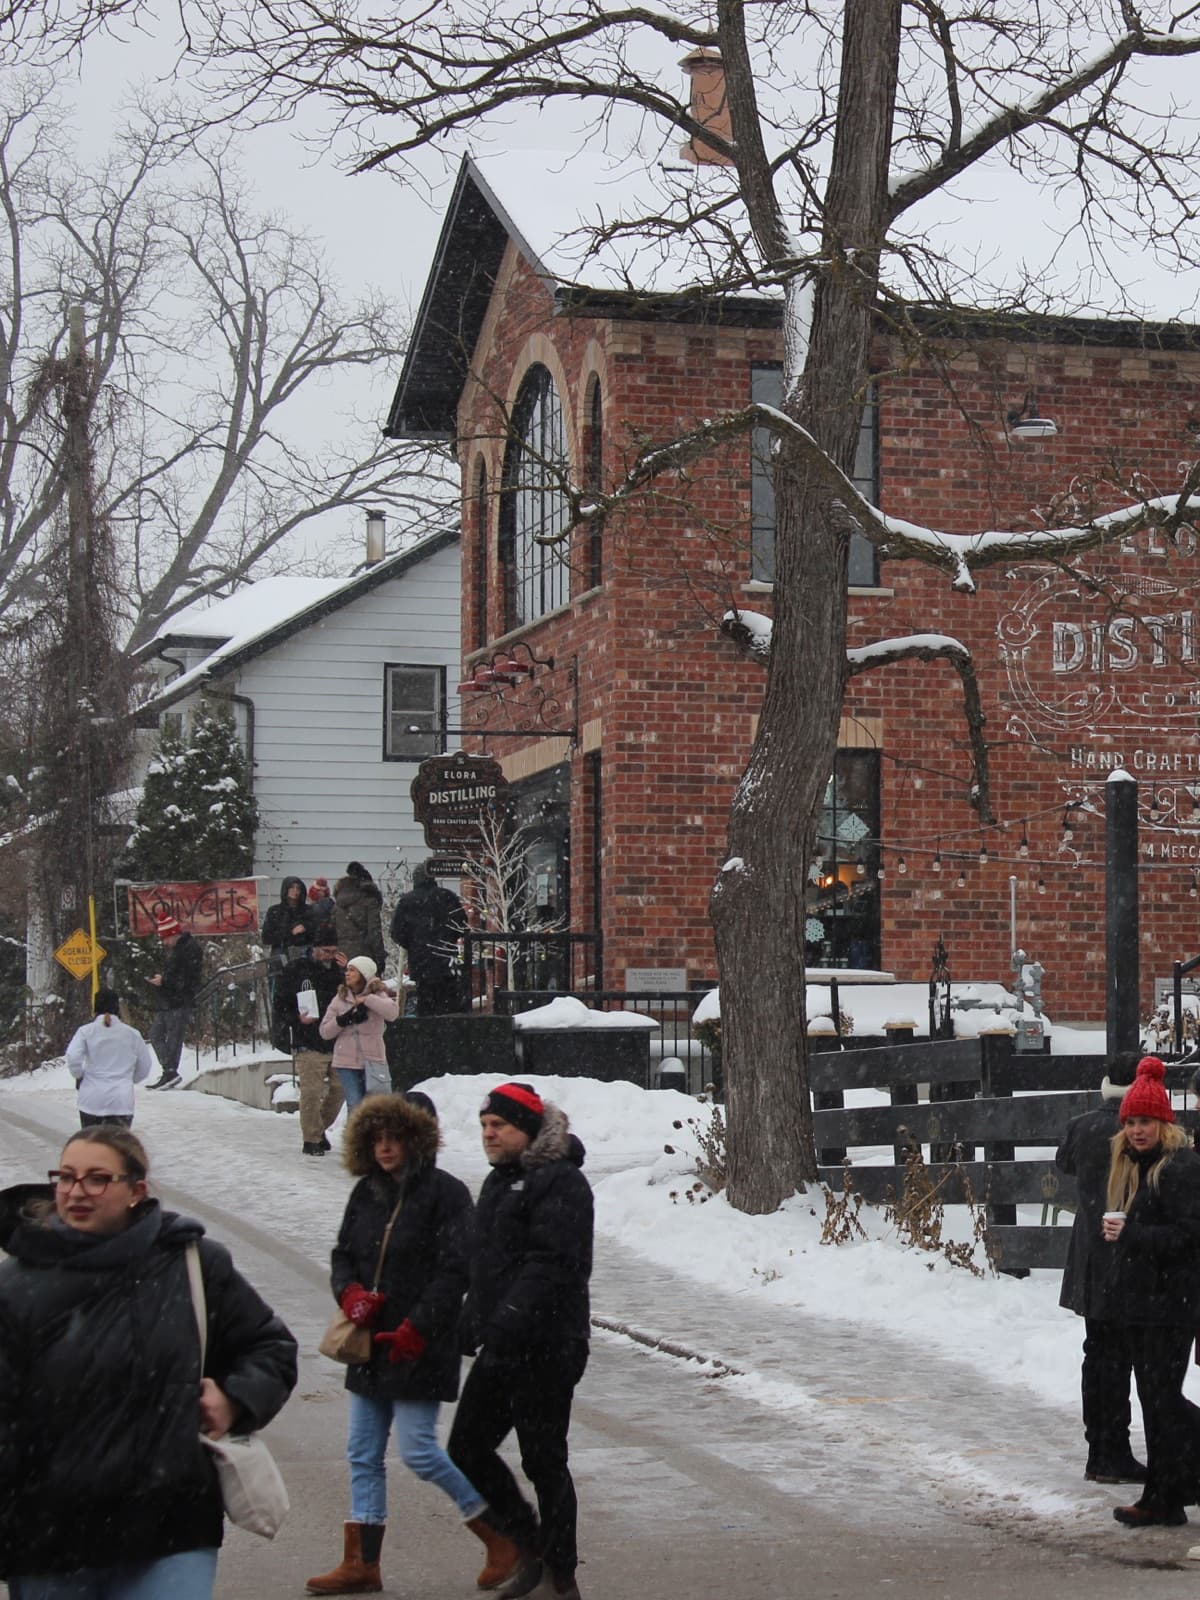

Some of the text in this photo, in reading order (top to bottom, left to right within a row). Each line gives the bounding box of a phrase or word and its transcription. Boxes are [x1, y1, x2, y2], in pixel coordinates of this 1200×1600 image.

[1071, 748, 1124, 770] HAND
[444, 770, 477, 779] ELORA
[429, 785, 496, 804] DISTILLING
